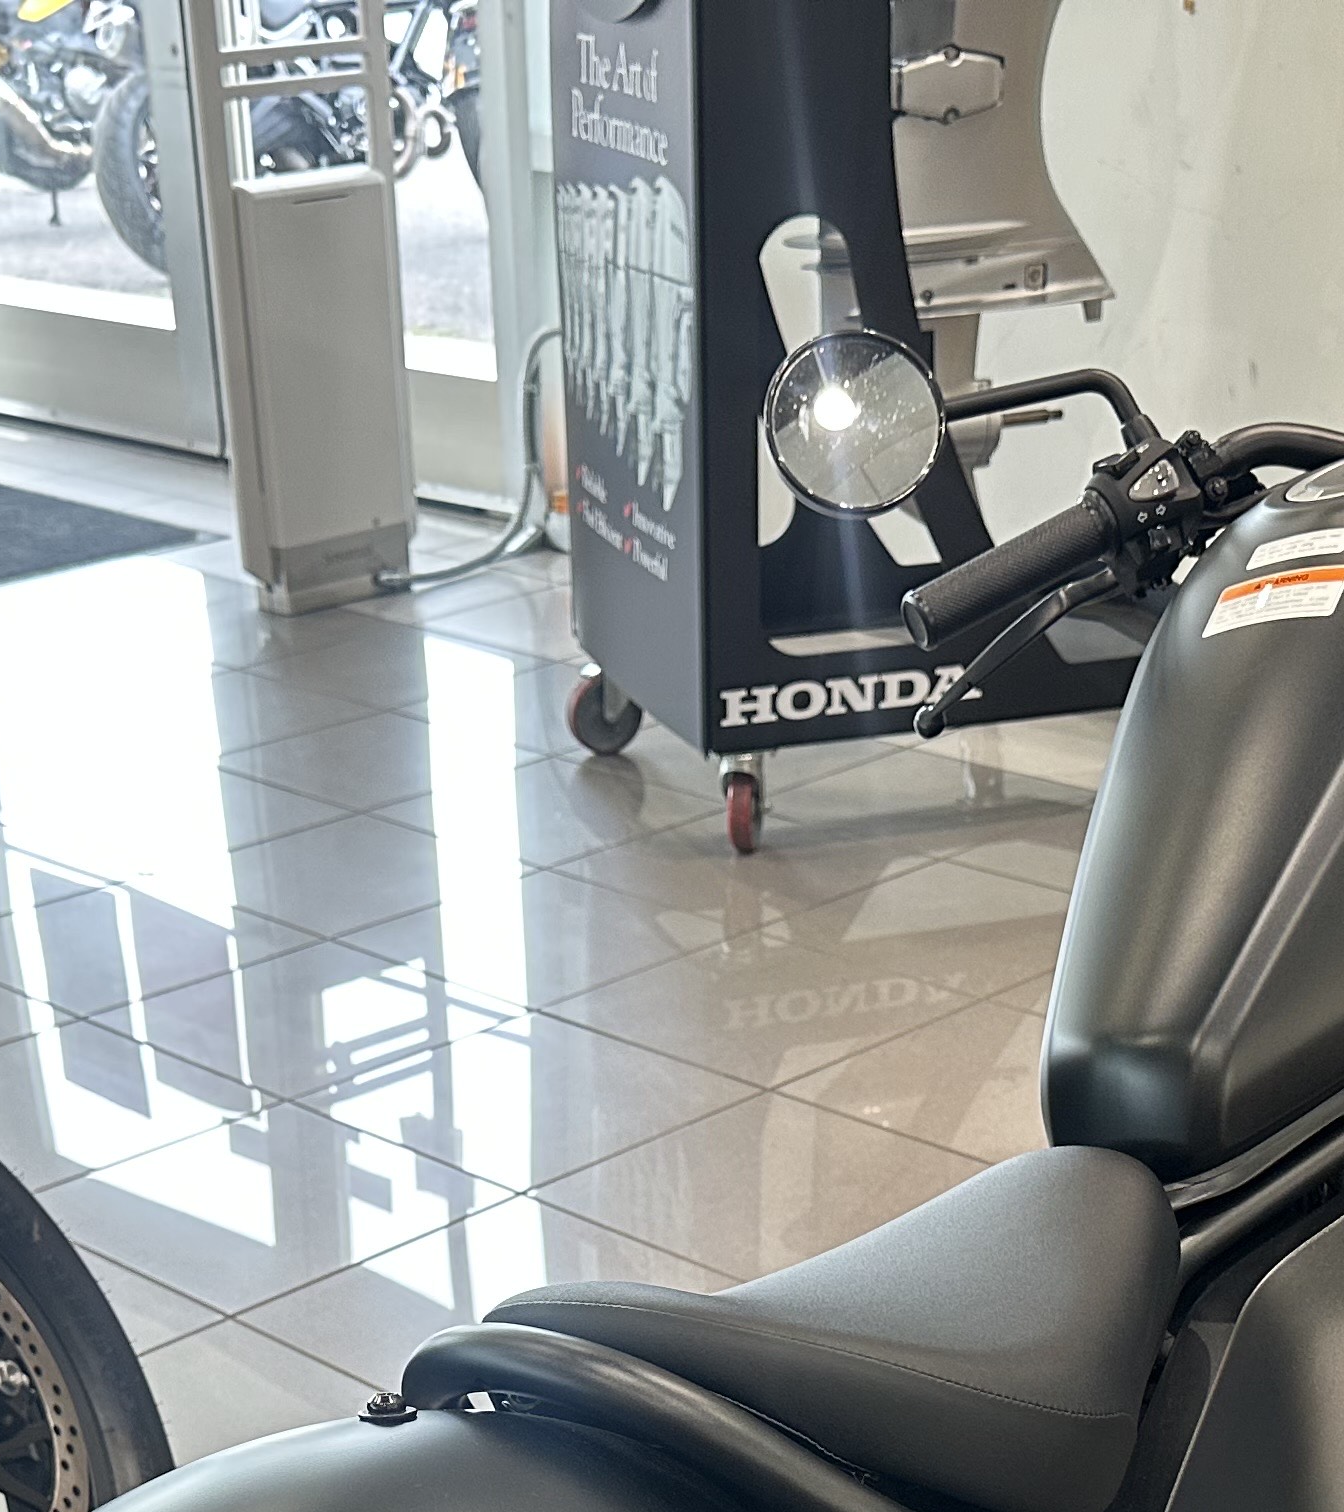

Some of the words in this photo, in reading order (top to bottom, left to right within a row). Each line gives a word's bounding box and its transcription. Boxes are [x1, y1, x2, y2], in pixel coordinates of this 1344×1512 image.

[576, 32, 611, 89] The
[612, 42, 643, 99] Art
[571, 87, 669, 166] Performance
[719, 664, 983, 728] HONDA
